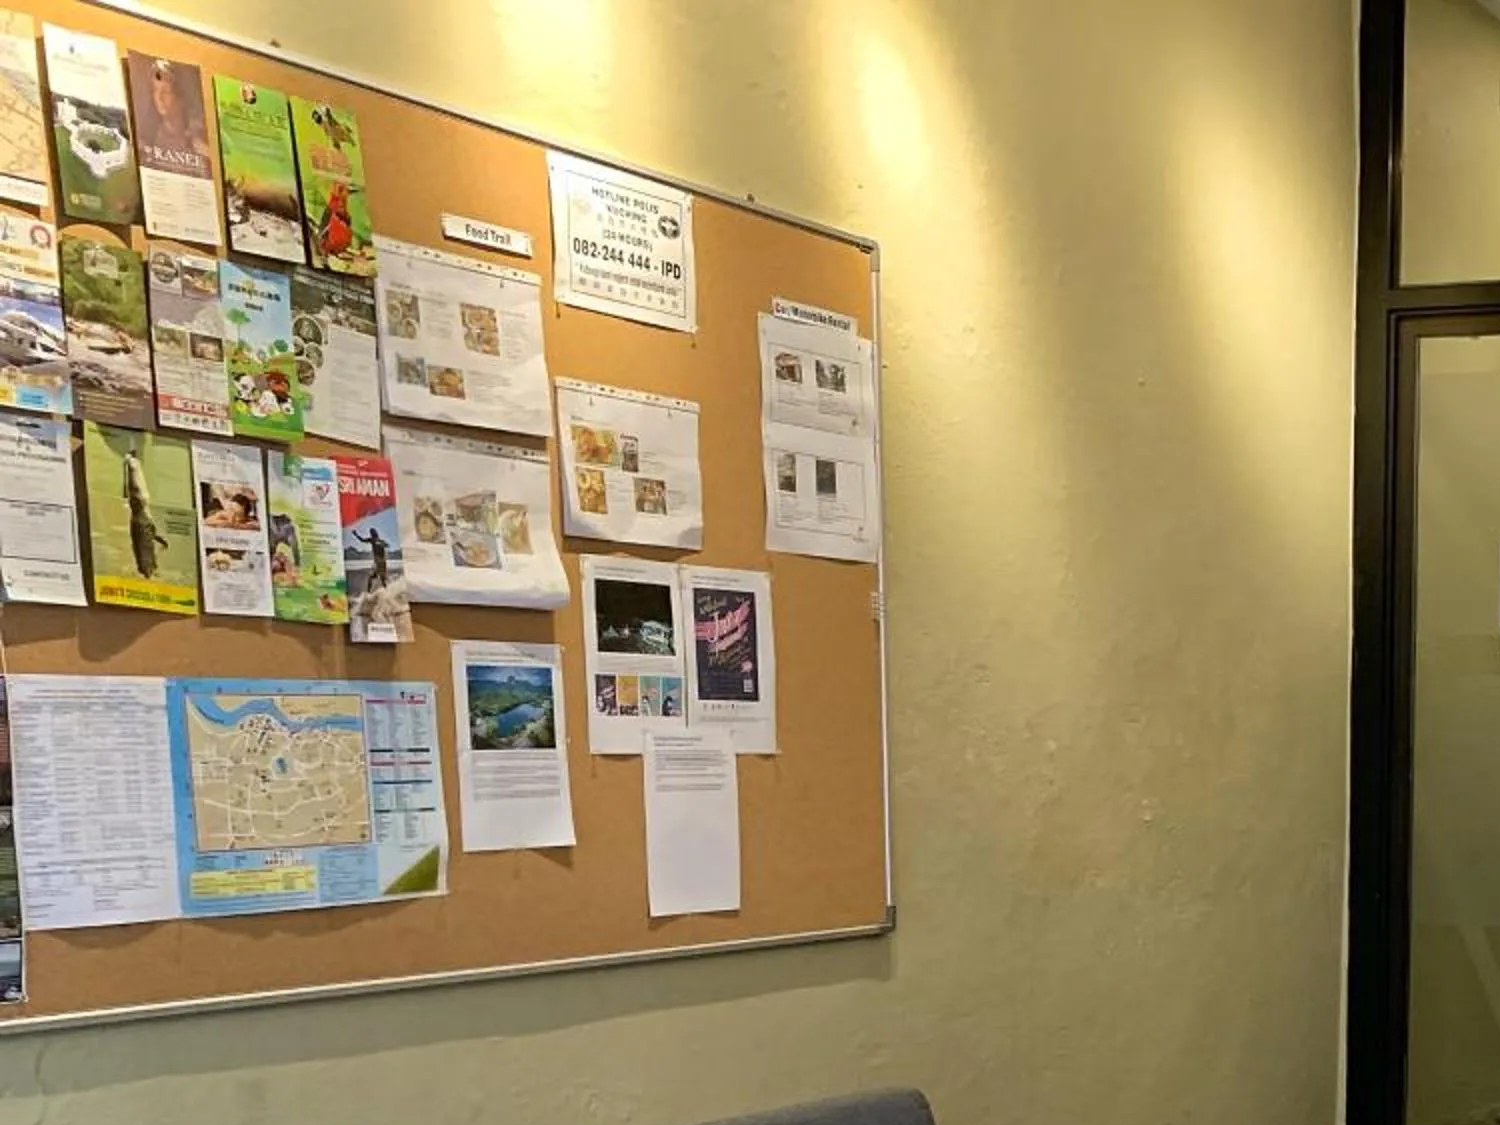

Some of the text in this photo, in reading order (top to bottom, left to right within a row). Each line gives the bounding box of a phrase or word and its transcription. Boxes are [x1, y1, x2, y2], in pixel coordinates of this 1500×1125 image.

[592, 186, 659, 214] HOTLINE POLIS
[465, 223, 511, 244] Food Trail
[573, 237, 624, 263] 082-244
[628, 252, 651, 271] 444
[661, 260, 681, 279] IPD
